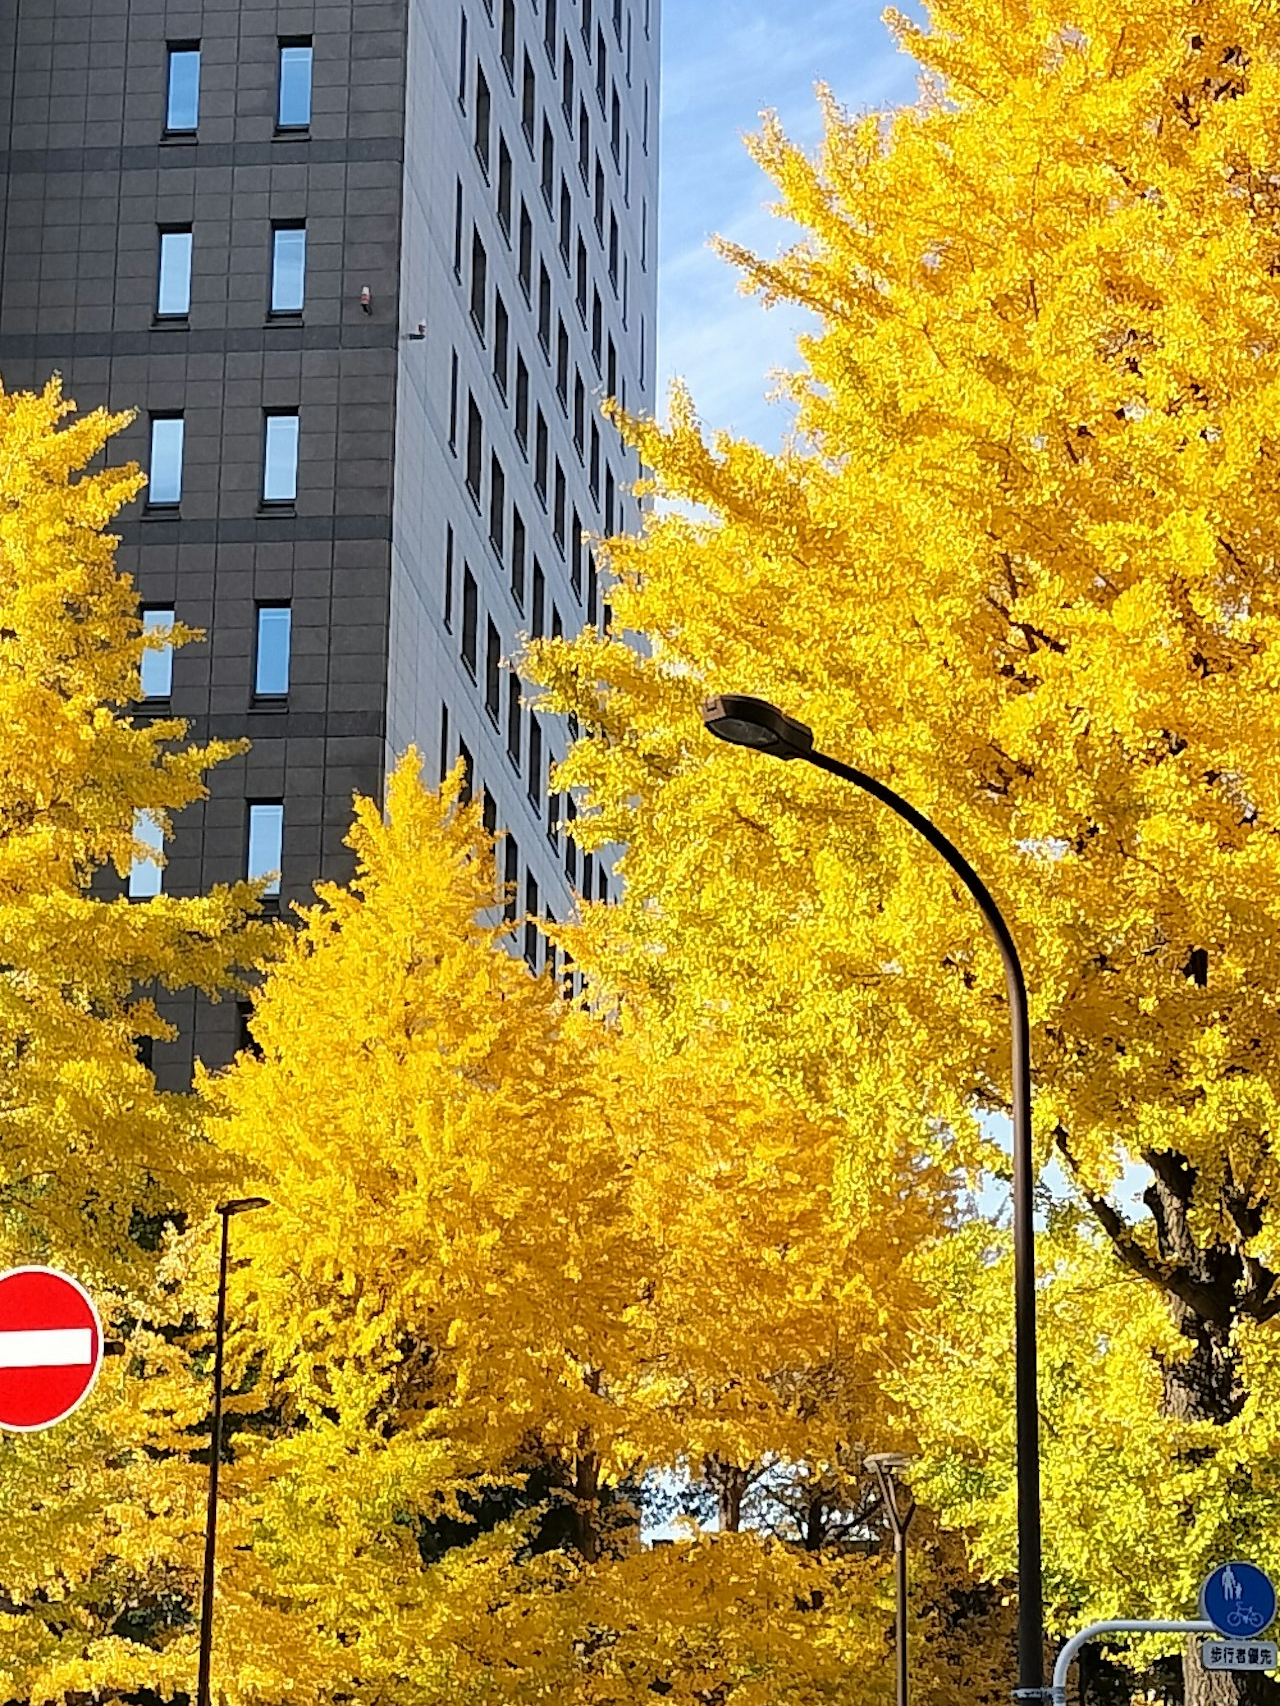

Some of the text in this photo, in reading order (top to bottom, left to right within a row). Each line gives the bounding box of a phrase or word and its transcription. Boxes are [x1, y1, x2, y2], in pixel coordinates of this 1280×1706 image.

[1210, 1646, 1272, 1664] 歩行者優先
